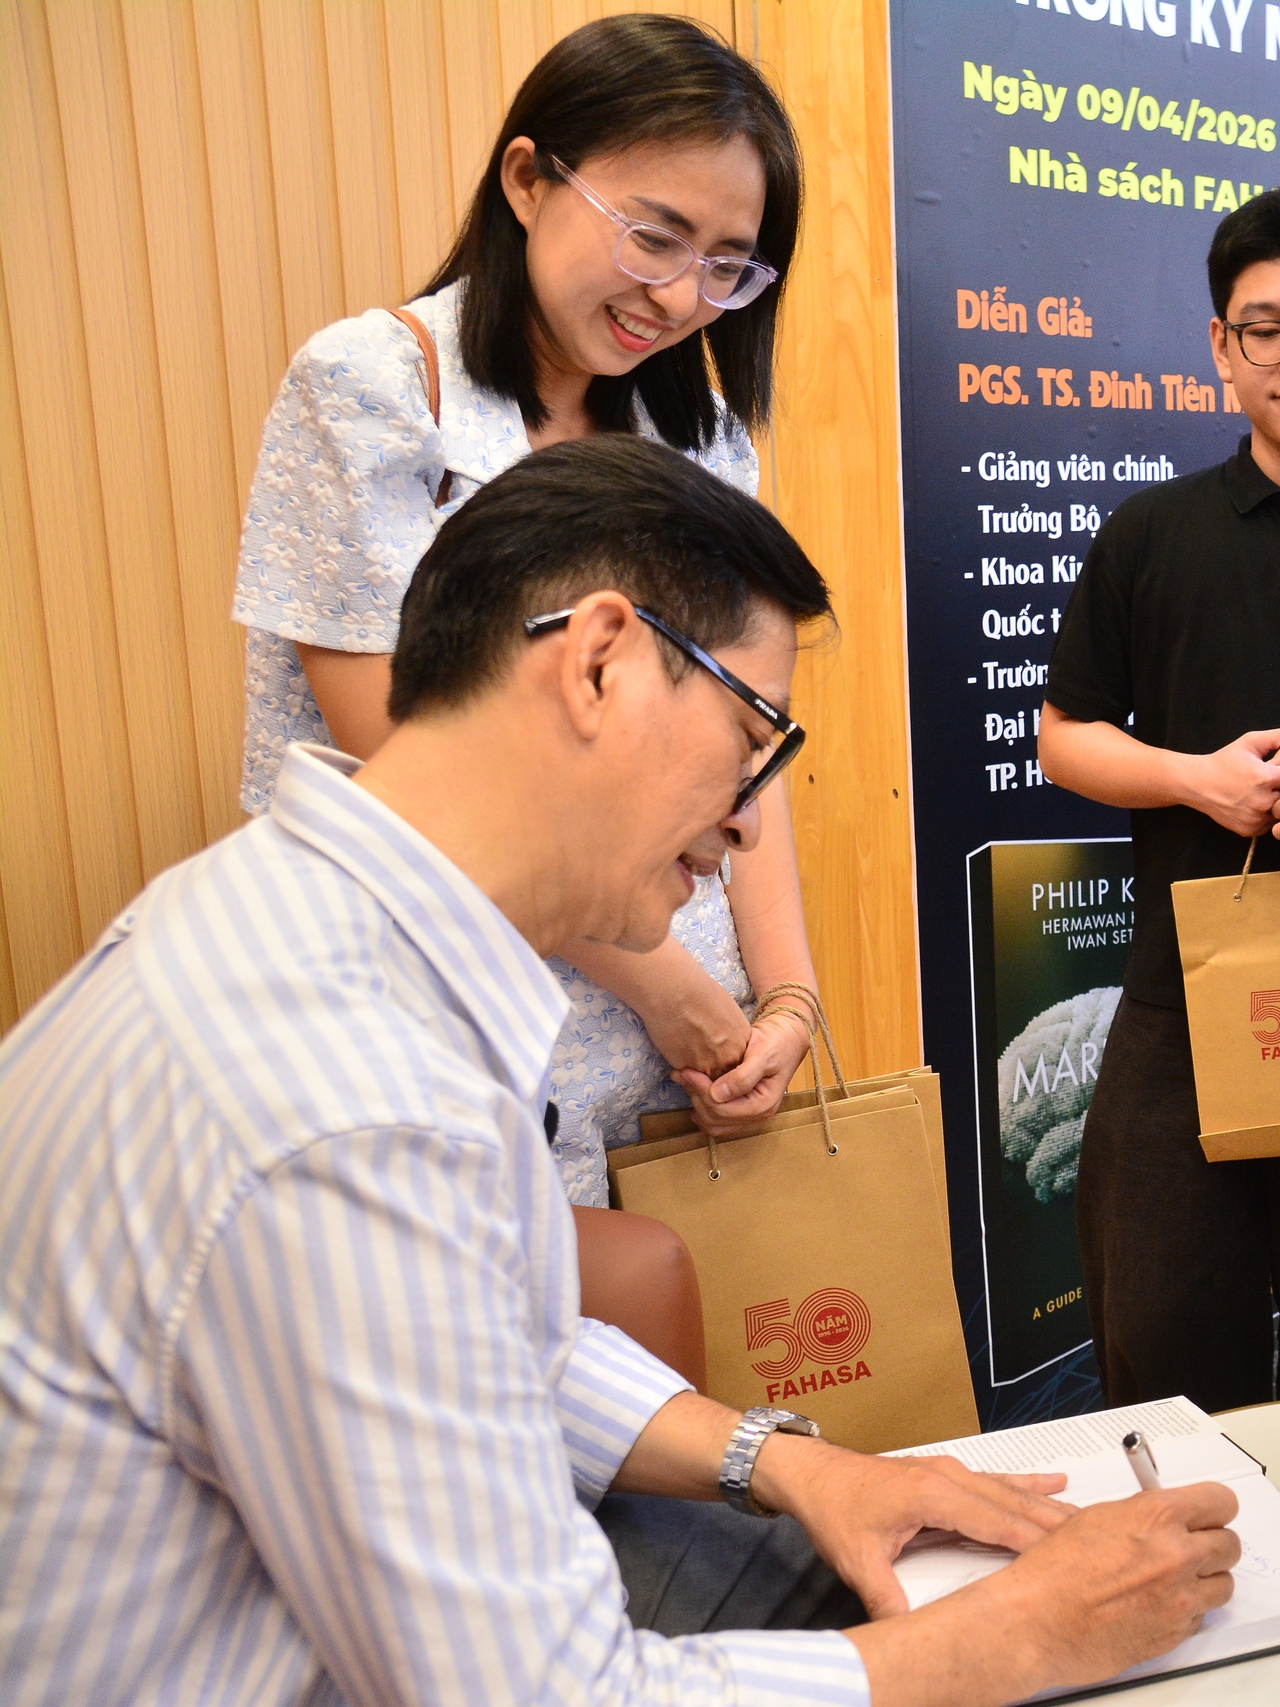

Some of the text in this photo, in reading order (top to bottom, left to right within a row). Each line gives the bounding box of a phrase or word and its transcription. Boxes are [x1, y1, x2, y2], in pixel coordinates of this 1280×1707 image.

[964, 61, 1066, 121] Ngày
[1076, 84, 1278, 153] 09/04/2026
[1009, 146, 1088, 193] Nhà
[1099, 161, 1185, 208] sách
[957, 287, 1093, 338] Diễn Giả:
[958, 364, 1029, 405] PGS.
[1037, 368, 1081, 407] TS.
[1089, 372, 1152, 410] Đinh
[1160, 373, 1217, 413] Tiên
[978, 451, 1050, 488] Giảng
[1057, 454, 1106, 482] viên
[978, 503, 1101, 539] Trưởng Bộ
[981, 556, 1044, 586] Khoa
[982, 603, 1045, 640] Quốc
[755, 698, 778, 720] PRADA
[985, 711, 1024, 745] Đại
[985, 763, 1018, 792] TP.
[1032, 879, 1109, 911] PHILIP
[1042, 912, 1126, 935] HERMAWAN
[1067, 932, 1107, 951] IWAN
[1033, 1287, 1082, 1320] A GUIDE
[745, 1287, 872, 1379] 50
[815, 1315, 848, 1332] NĂM
[766, 1360, 872, 1403] FAHASA
